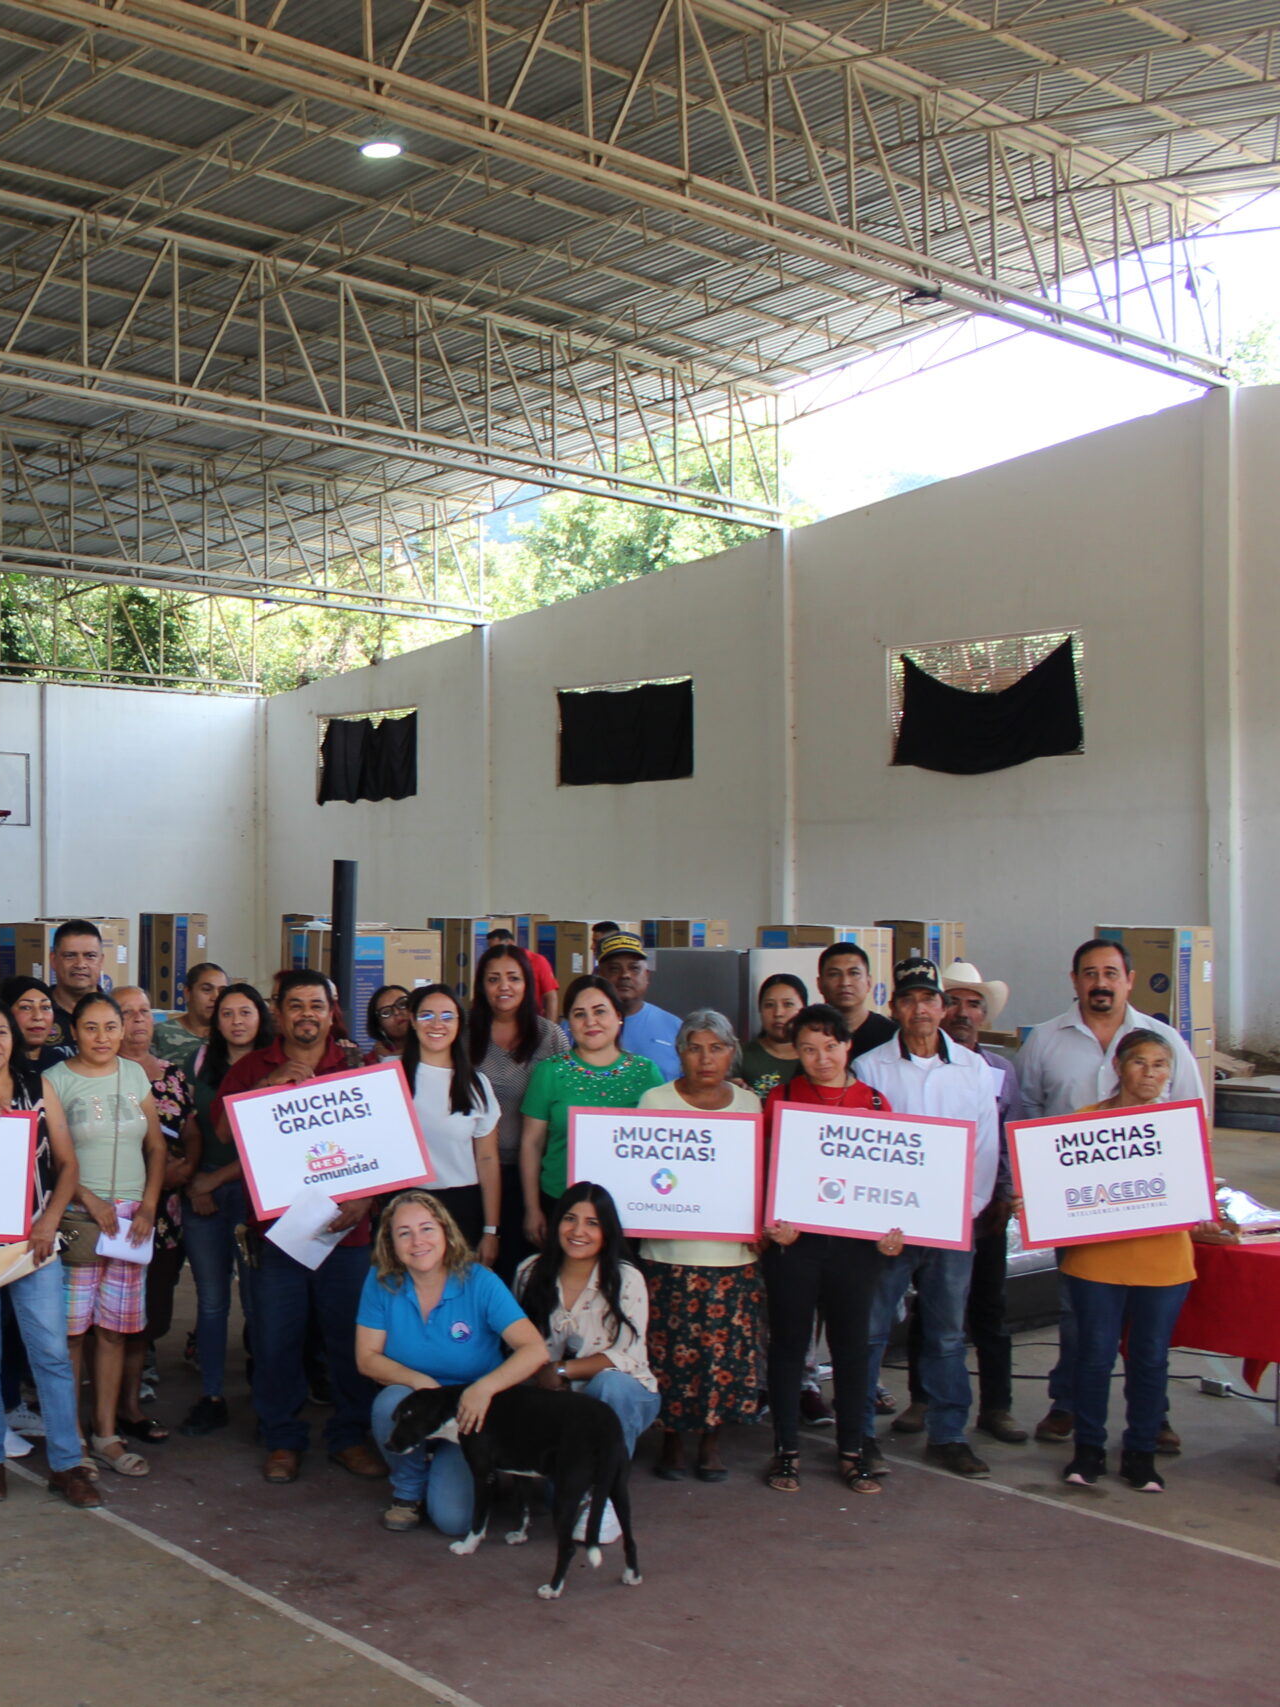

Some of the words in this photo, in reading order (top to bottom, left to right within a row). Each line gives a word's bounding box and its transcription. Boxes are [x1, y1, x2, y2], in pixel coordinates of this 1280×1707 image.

[272, 1087, 364, 1121] ¡MUCHAS
[279, 1103, 372, 1134] GRACIAS!
[613, 1126, 712, 1144] ¡MUCHAS
[819, 1124, 922, 1148] ¡MUCHAS
[1054, 1123, 1156, 1153] ¡MUCHAS
[615, 1144, 716, 1162] GRACIAS!
[820, 1142, 925, 1166] GRACIAS!
[1059, 1140, 1162, 1167] GRACIAS!
[303, 1159, 379, 1185] comunidad
[853, 1185, 921, 1208] FRISA
[1065, 1177, 1166, 1206] DEACERO
[627, 1202, 701, 1213] COMUNIDAR
